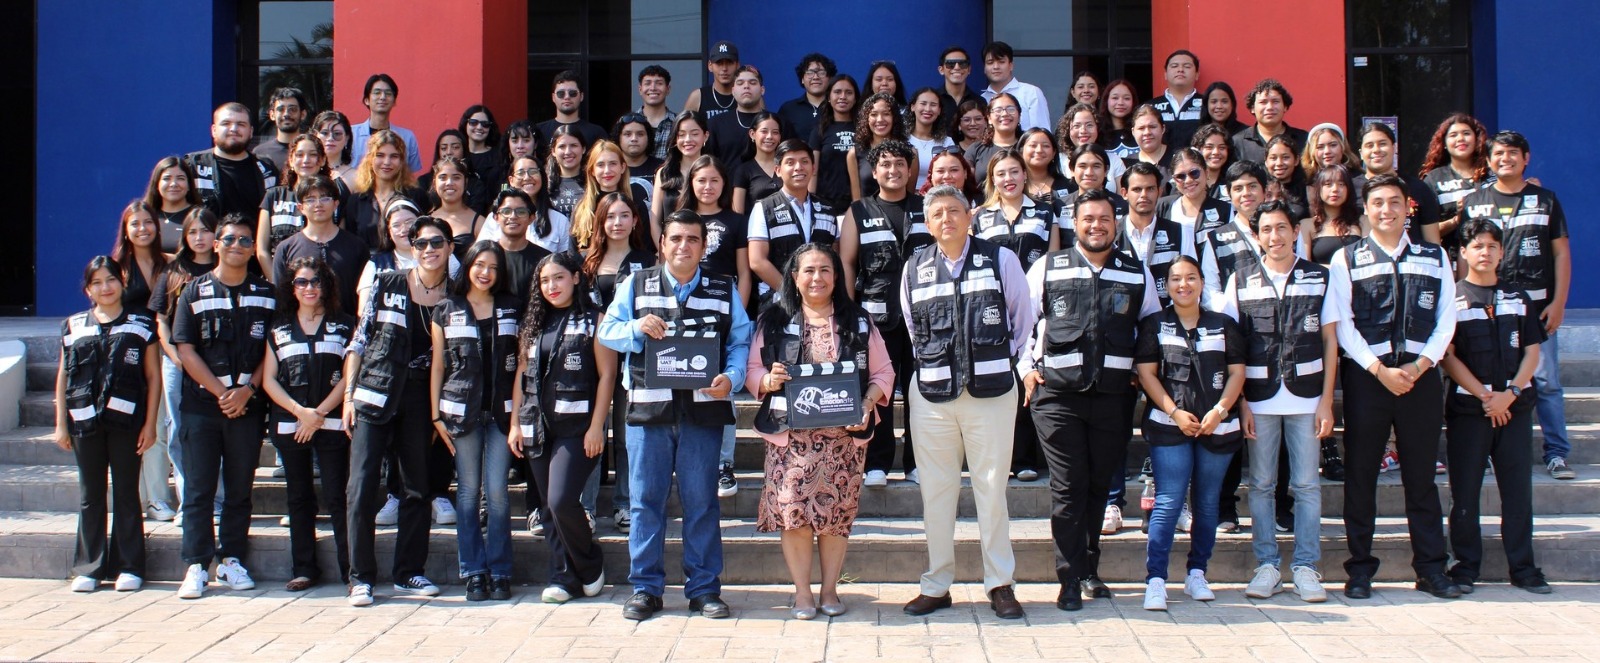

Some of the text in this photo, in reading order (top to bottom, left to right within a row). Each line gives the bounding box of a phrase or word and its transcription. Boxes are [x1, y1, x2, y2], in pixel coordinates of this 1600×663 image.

[1437, 179, 1464, 191] UAT
[273, 201, 299, 213] UAT
[1467, 204, 1495, 219] UAT
[862, 217, 885, 228] UAT
[1215, 231, 1238, 242] UAT
[919, 271, 934, 280] UAT
[383, 292, 407, 310] UAT
